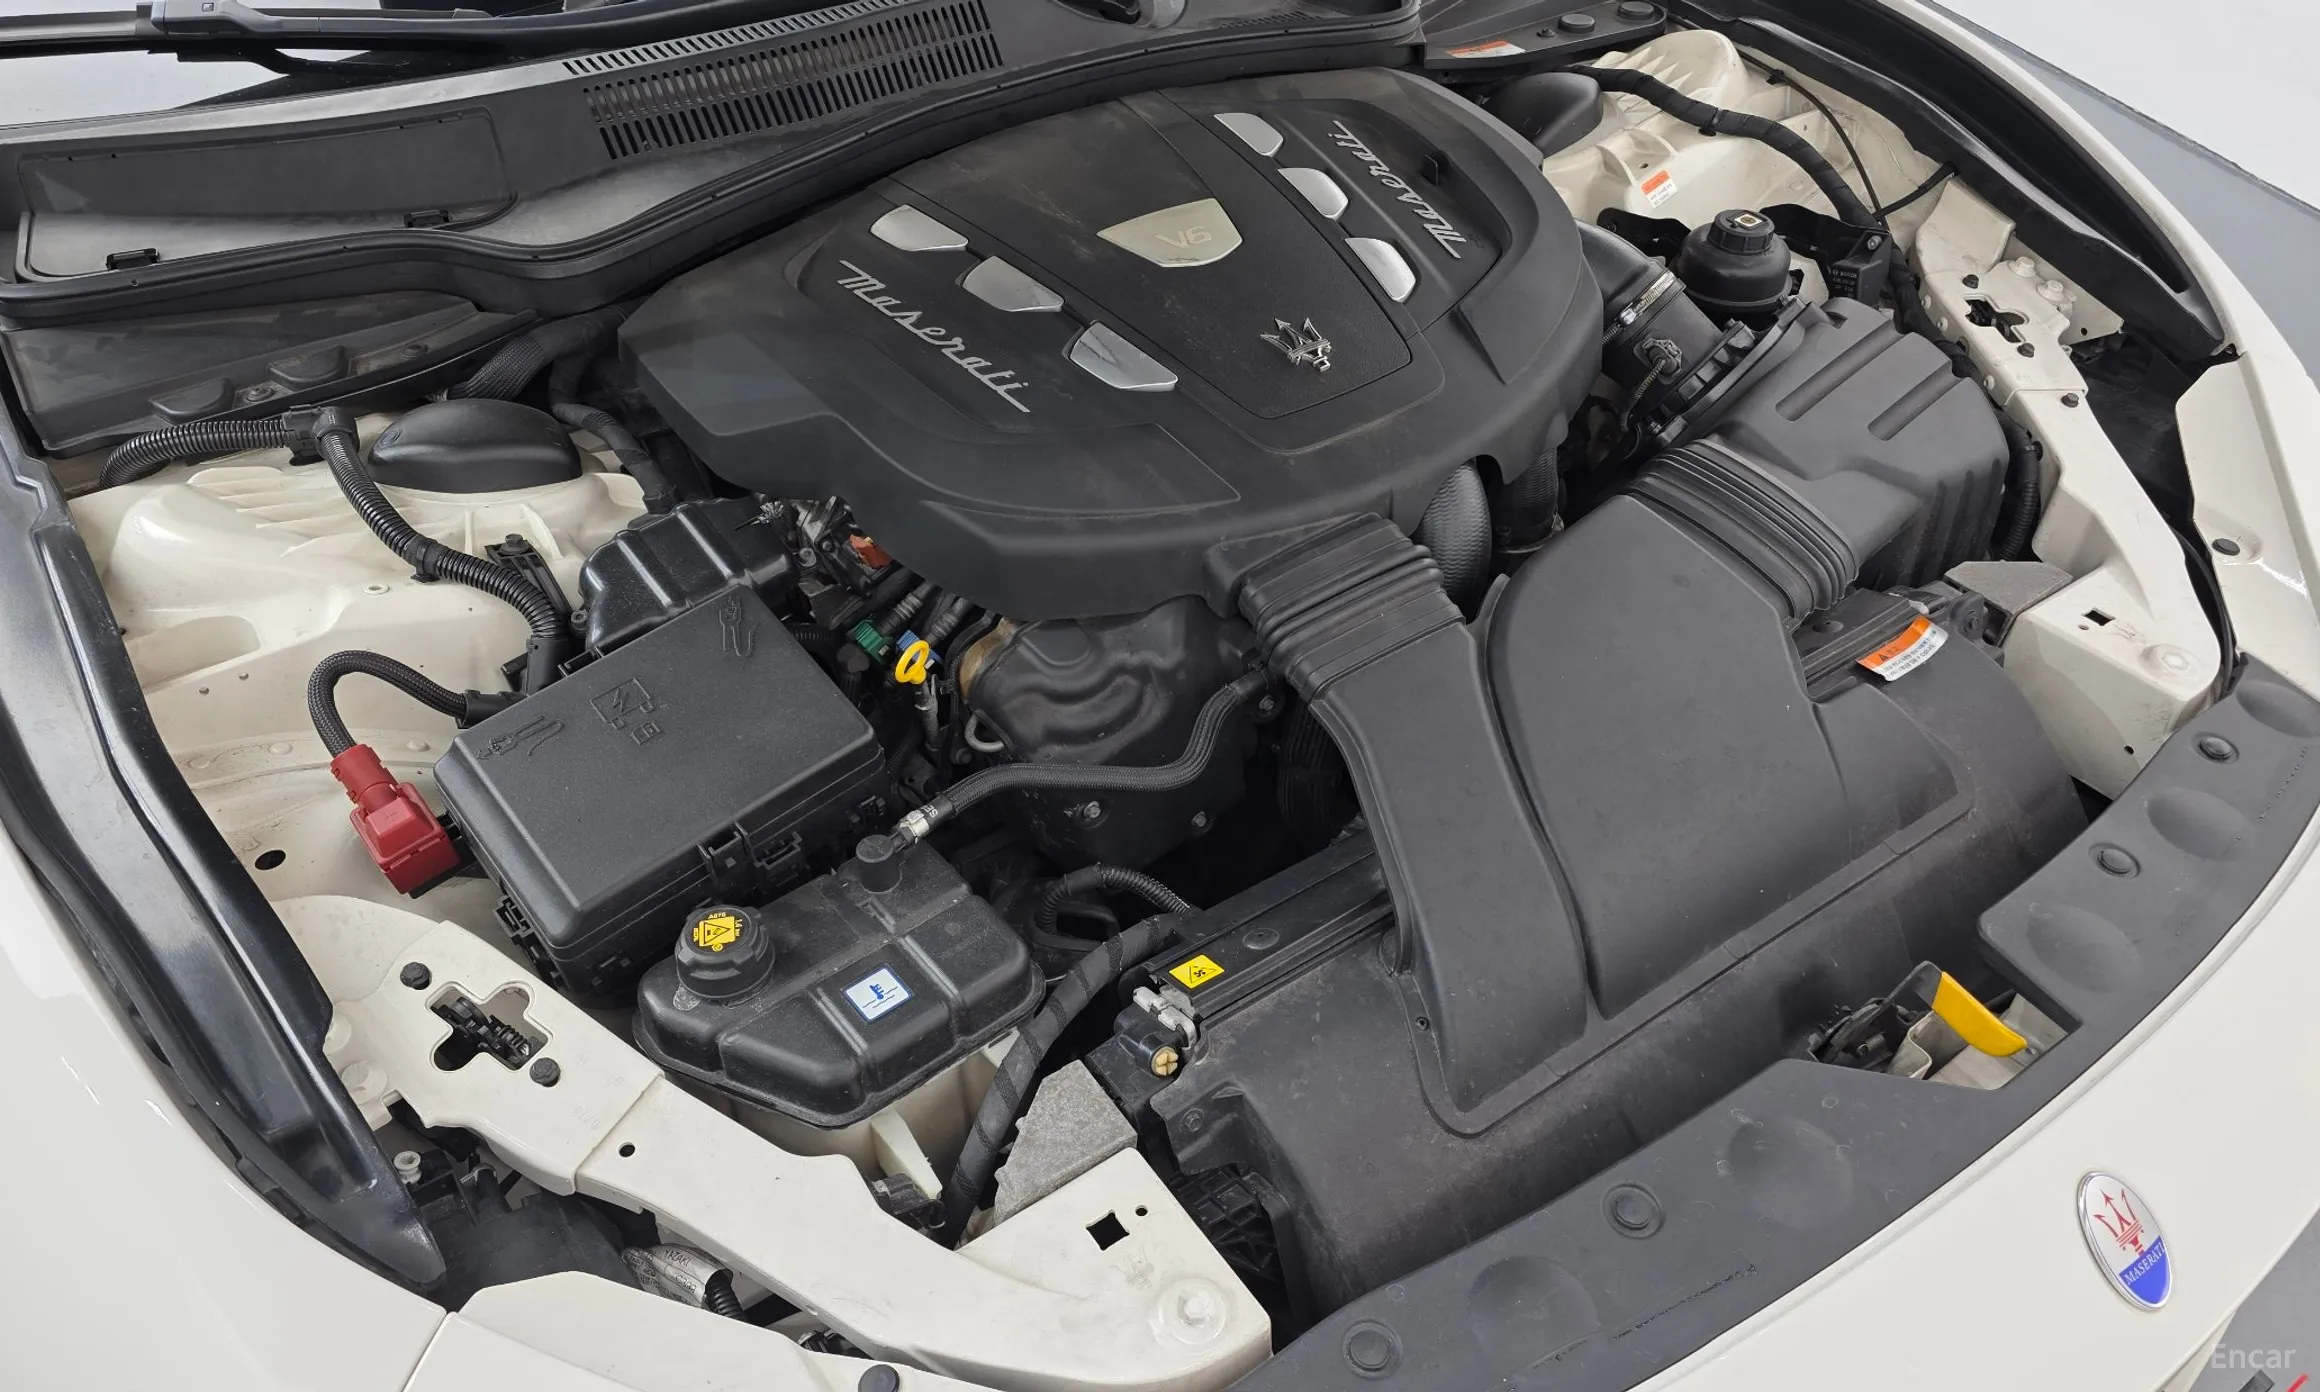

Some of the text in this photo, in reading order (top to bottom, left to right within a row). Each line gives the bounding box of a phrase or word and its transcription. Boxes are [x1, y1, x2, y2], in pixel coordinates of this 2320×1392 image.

[1327, 120, 1467, 259] Maserati
[1155, 225, 1212, 249] V6
[837, 260, 1031, 413] Maserati
[665, 1248, 690, 1267] YAZAKI
[2124, 1242, 2165, 1285] MASERATI
